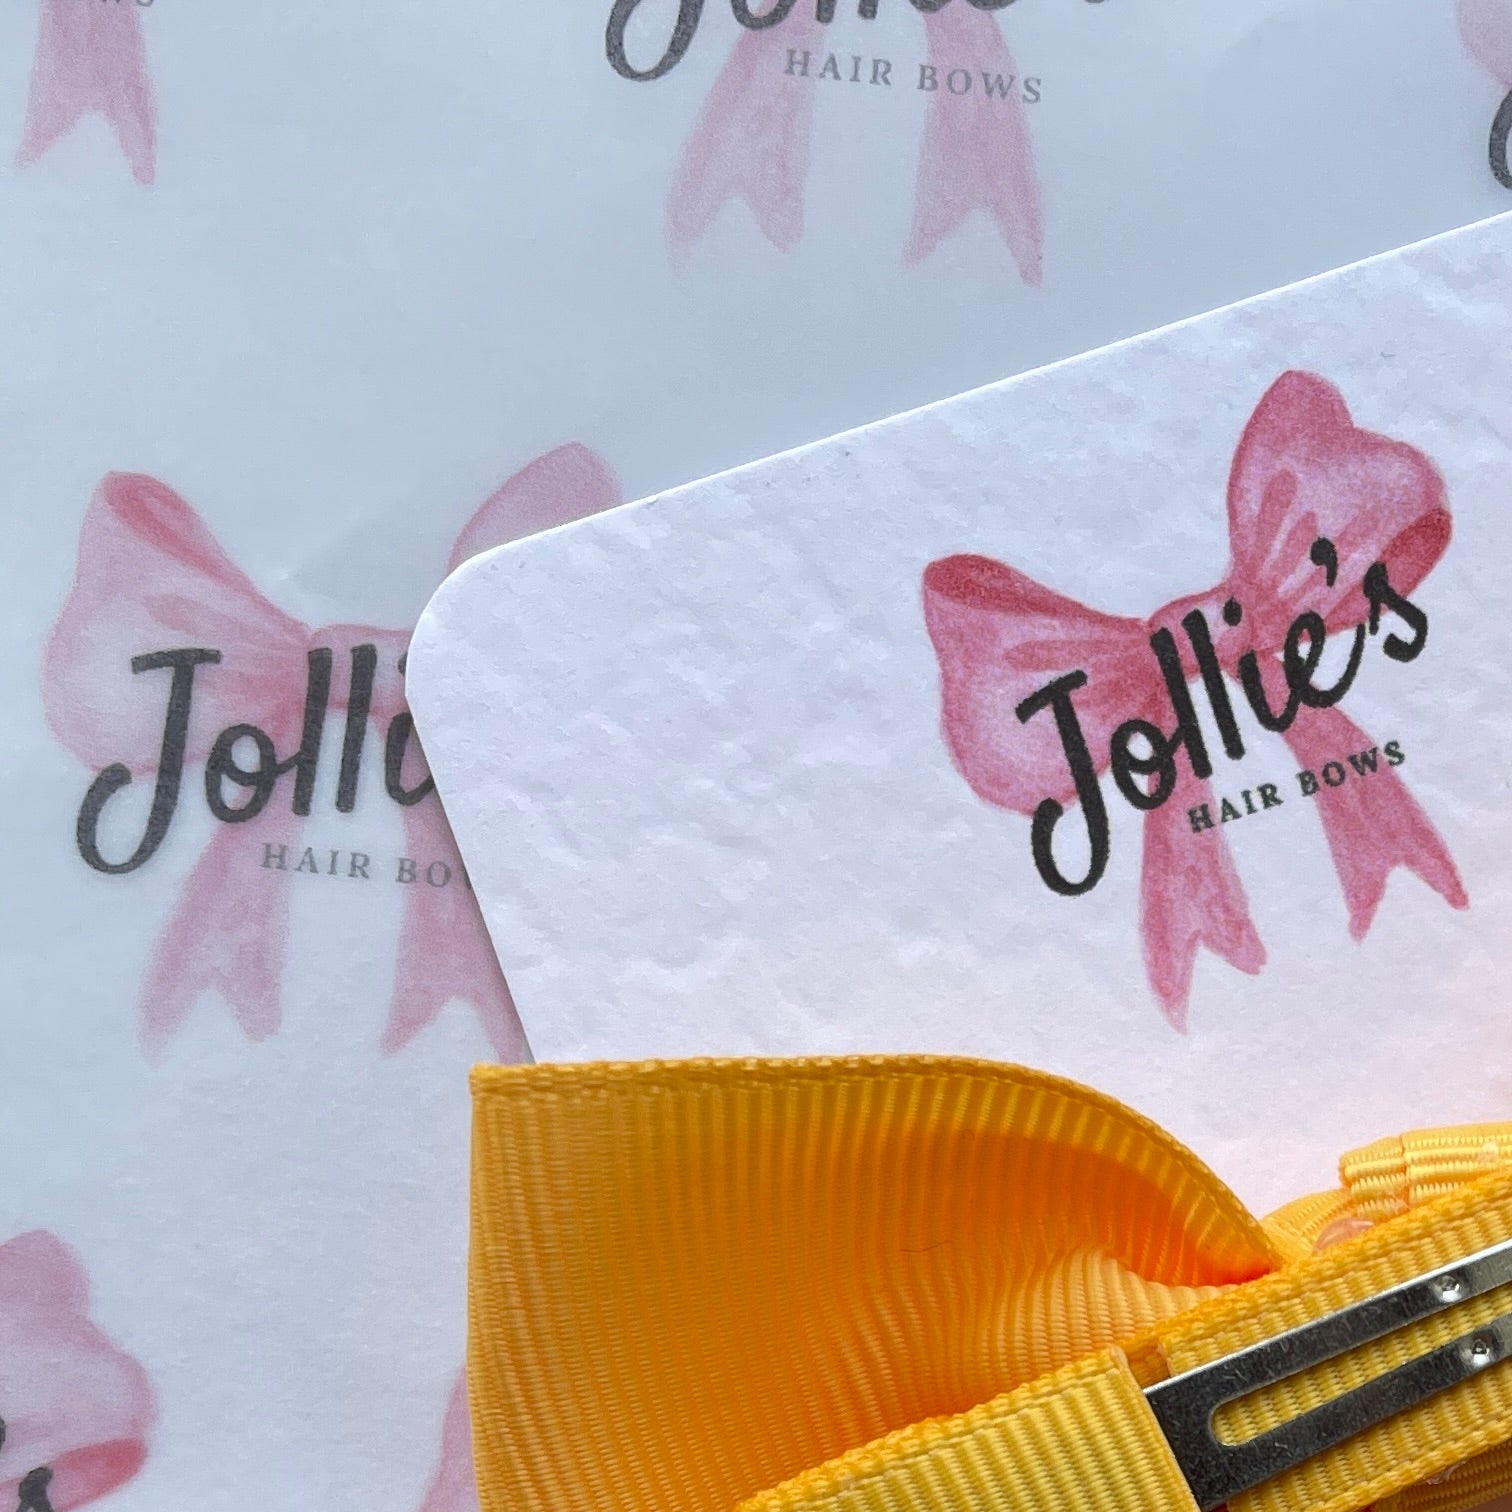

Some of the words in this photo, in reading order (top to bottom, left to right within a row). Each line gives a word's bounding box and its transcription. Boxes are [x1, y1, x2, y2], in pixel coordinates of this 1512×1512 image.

[784, 48, 892, 87] HAIR
[917, 63, 1043, 105] BOWS
[77, 644, 437, 873] Jolli
[1015, 537, 1428, 896] Jollie's
[1187, 781, 1284, 834] HAIR
[1298, 740, 1407, 798] BOWS
[260, 842, 371, 879] HAIR
[395, 857, 472, 890] BO
